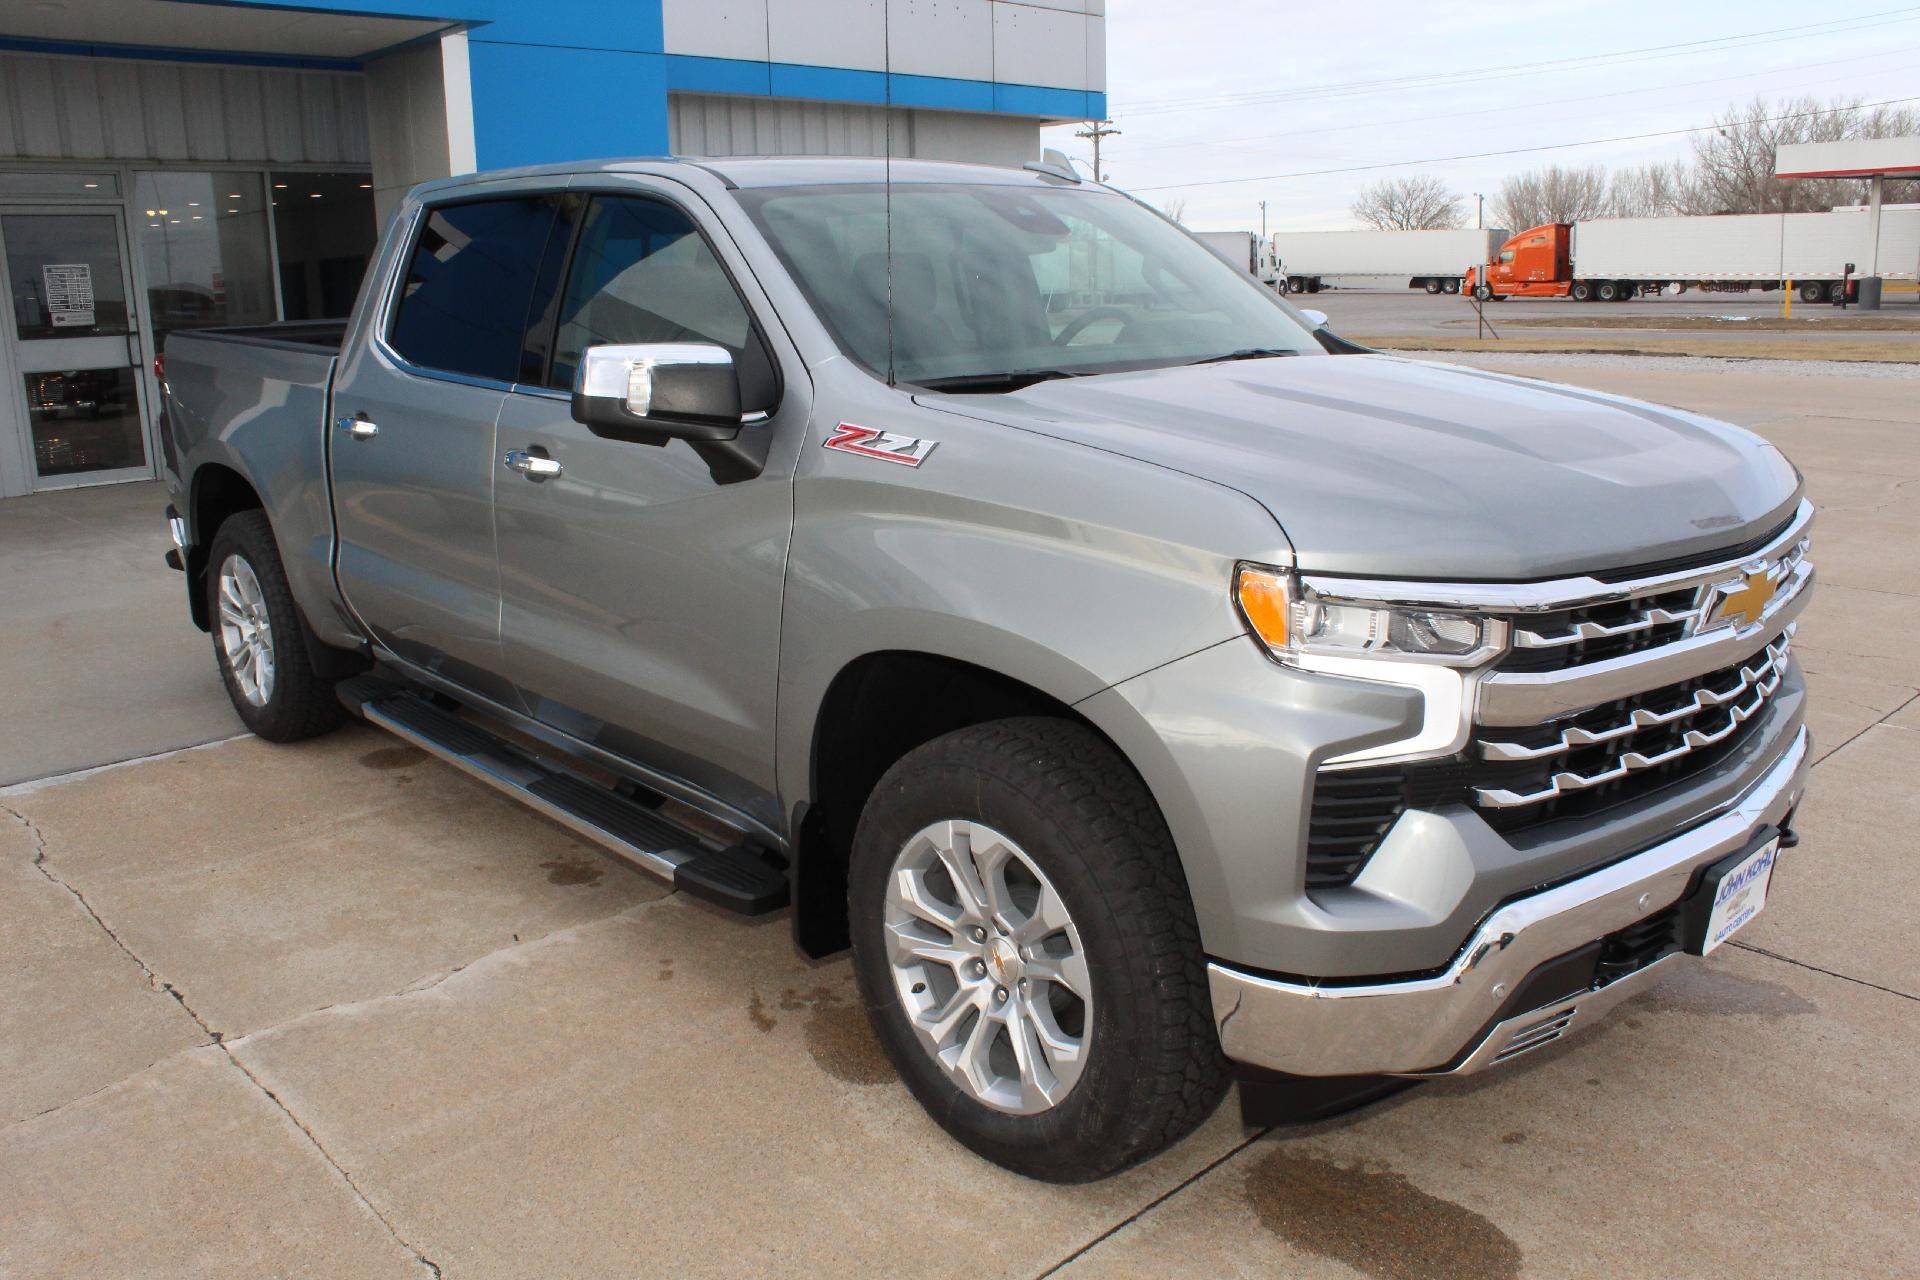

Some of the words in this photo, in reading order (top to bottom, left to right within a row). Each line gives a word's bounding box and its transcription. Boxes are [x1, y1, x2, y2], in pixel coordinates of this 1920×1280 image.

[823, 422, 938, 468] Z71
[1715, 869, 1746, 907] JOHN
[1745, 848, 1772, 880] KOHL
[1718, 922, 1733, 938] AUTO
[1732, 908, 1751, 930] CENTER
